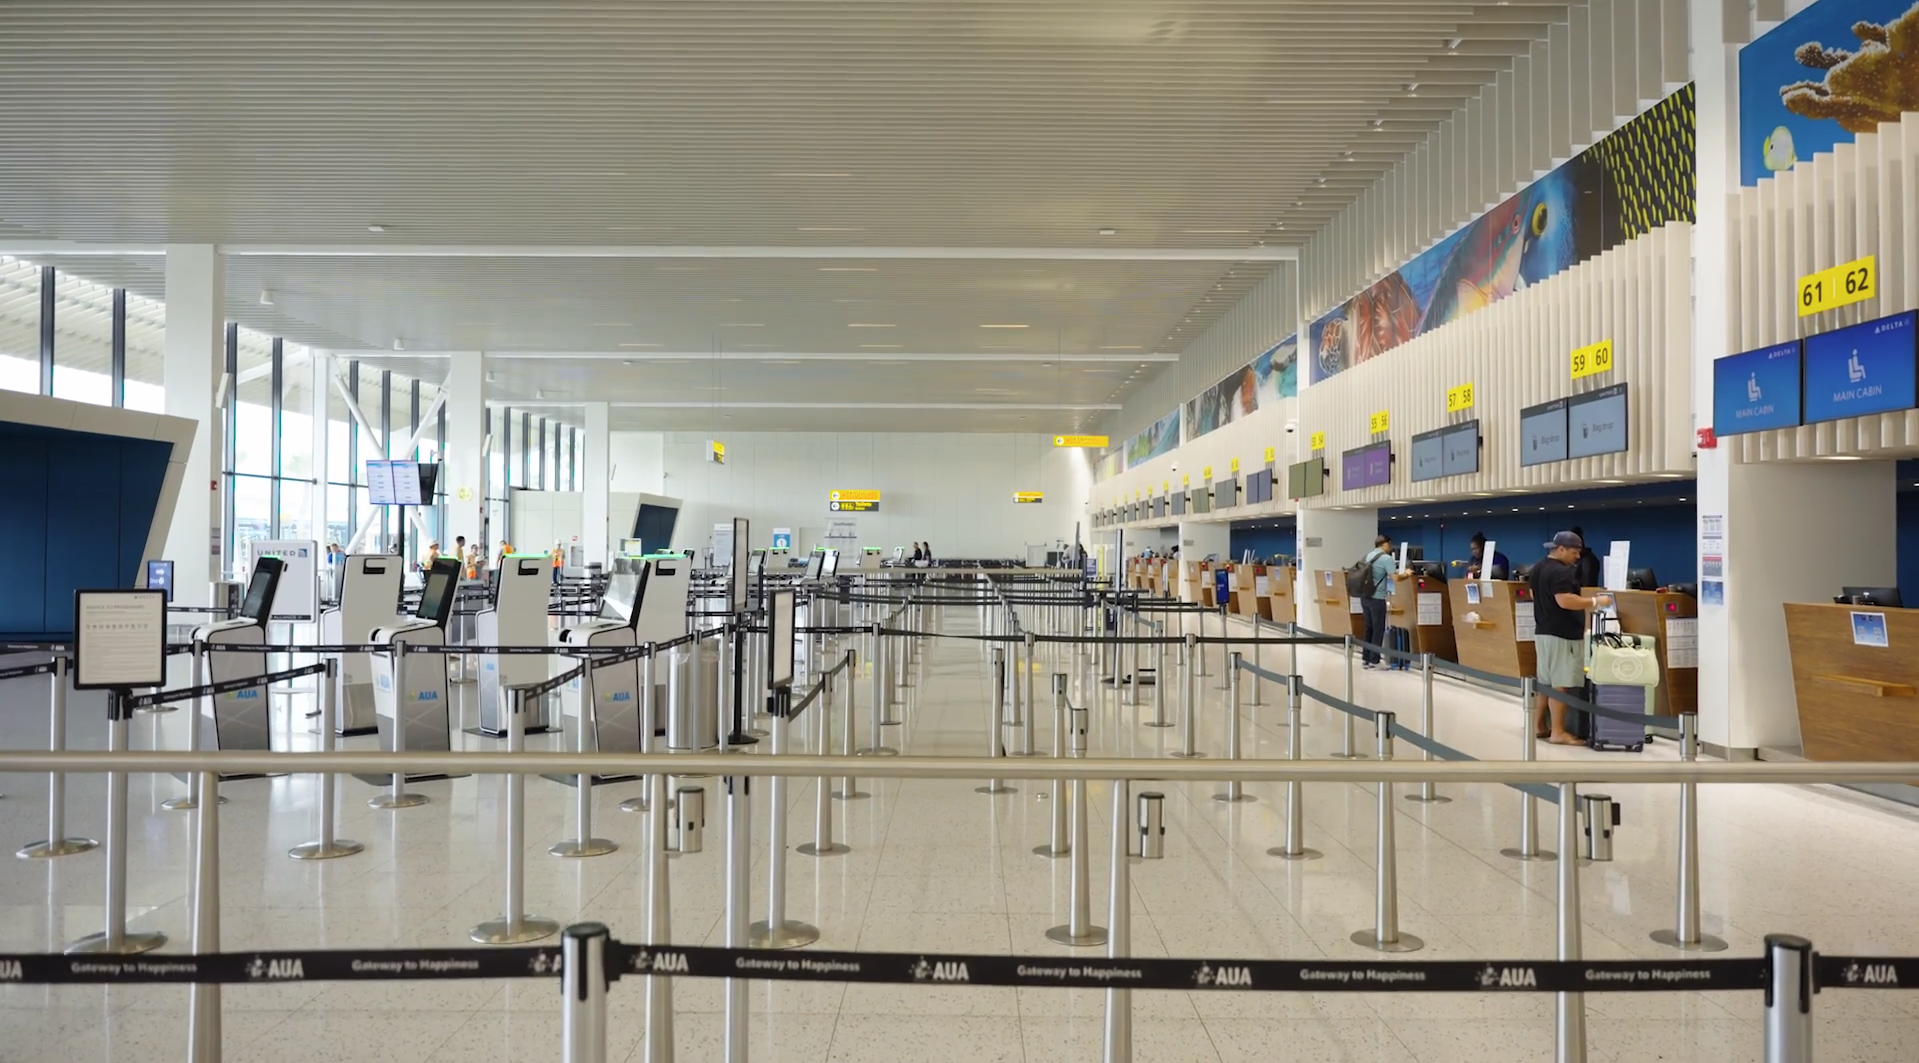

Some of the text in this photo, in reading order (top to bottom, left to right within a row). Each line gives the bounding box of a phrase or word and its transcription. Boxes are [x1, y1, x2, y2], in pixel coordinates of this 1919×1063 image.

[1803, 267, 1869, 306] 61 62
[1881, 320, 1903, 332] DELTA
[1574, 347, 1608, 372] 59 60
[1773, 348, 1791, 358] DELTA
[1449, 388, 1471, 407] 57 58
[1833, 385, 1882, 402] MAIN CABIN
[1736, 404, 1774, 418] MAIN CABIN
[1592, 422, 1614, 434] Bag drop
[257, 549, 296, 557] UNITED
[237, 690, 258, 699] AUA
[418, 691, 438, 700] AUA
[613, 692, 630, 702] AUA
[0, 959, 23, 979] UA
[71, 962, 198, 975] Gateway to Happiness
[268, 958, 304, 978] AUA
[351, 958, 479, 973] Gateway to Happiness
[653, 952, 689, 973] AUA
[735, 957, 860, 973] Gateway to Happiness
[933, 961, 969, 981] AUA
[1017, 964, 1142, 980] Gateway to Happiness
[1215, 966, 1252, 985] AUA
[1300, 968, 1426, 983] Gateway to Happiness
[1500, 967, 1536, 986] AUA
[1585, 968, 1711, 983] Gateway to Happiness
[1864, 964, 1897, 983] AUA
